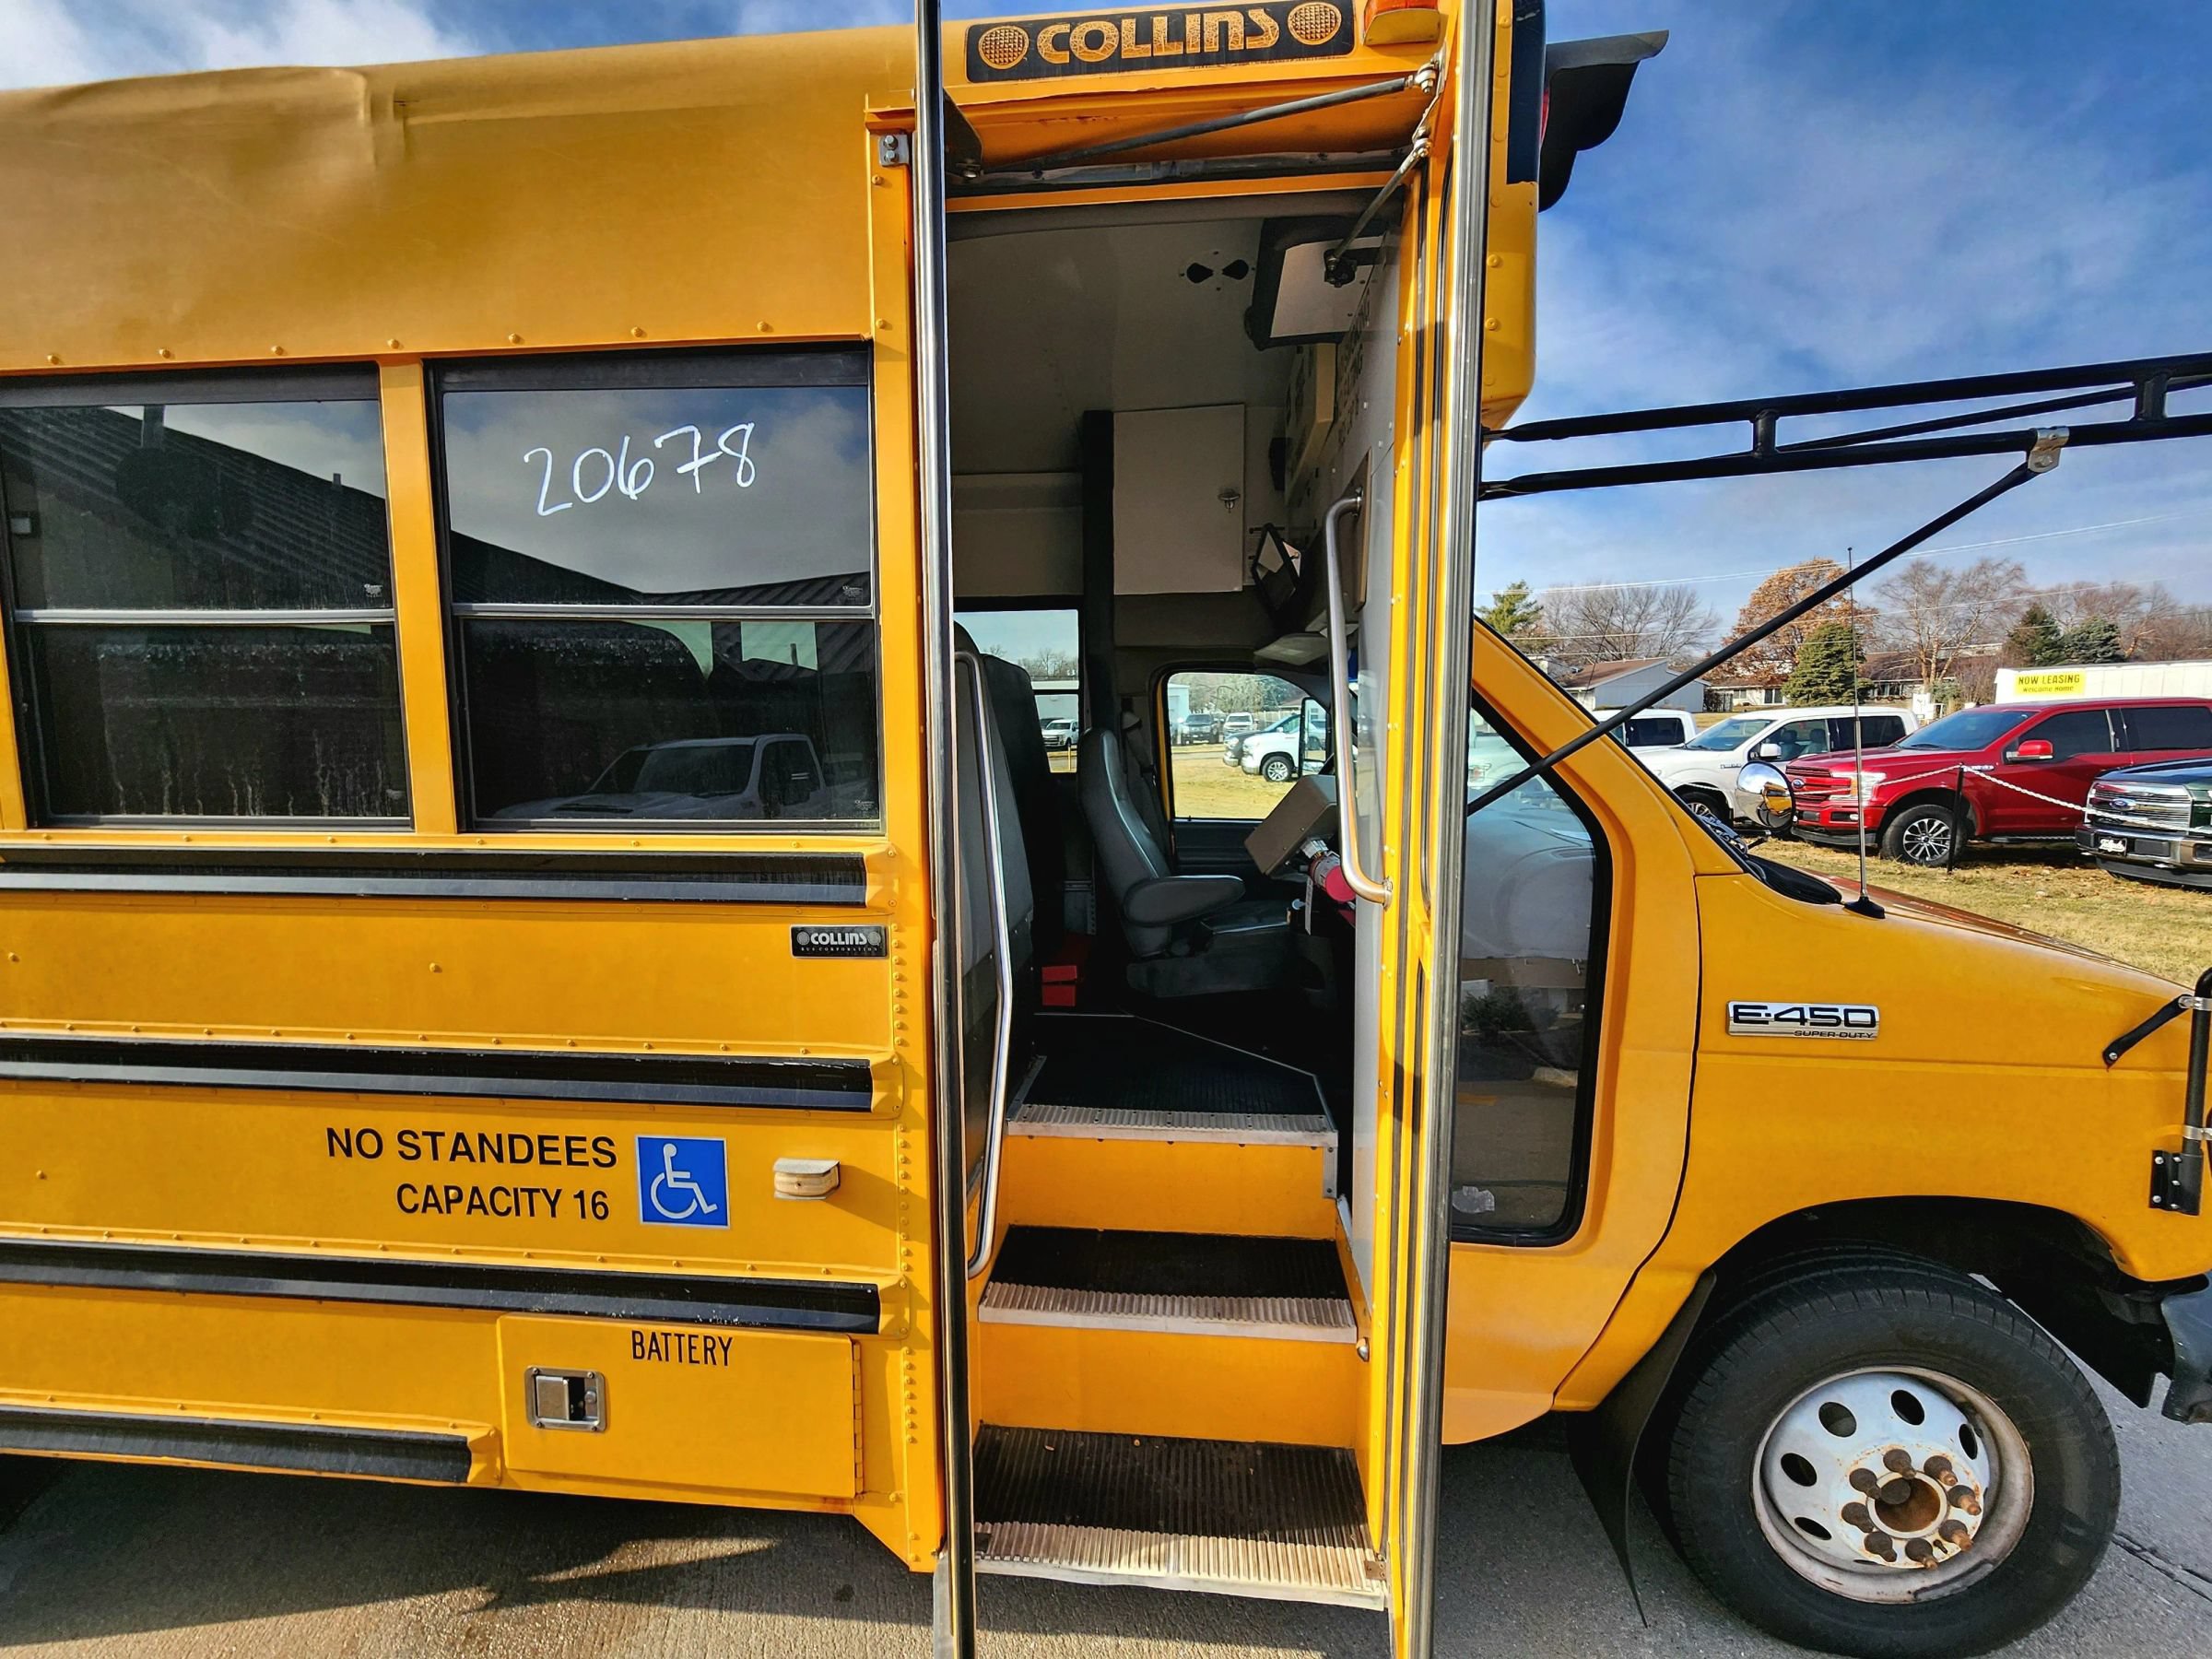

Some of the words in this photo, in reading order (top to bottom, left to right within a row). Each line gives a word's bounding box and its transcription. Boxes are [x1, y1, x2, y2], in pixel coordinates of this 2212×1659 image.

[1036, 8, 1280, 65] COLLINS
[524, 422, 756, 516] 20678
[2018, 676, 2039, 685] NOW
[2042, 674, 2080, 685] LEASING
[810, 932, 867, 946] COLLINS
[326, 1127, 383, 1159] NO
[397, 1129, 618, 1169] STANDEES
[396, 1182, 562, 1218] CAPACITY
[572, 1189, 610, 1220] 16
[631, 1330, 733, 1367] BATTERY
